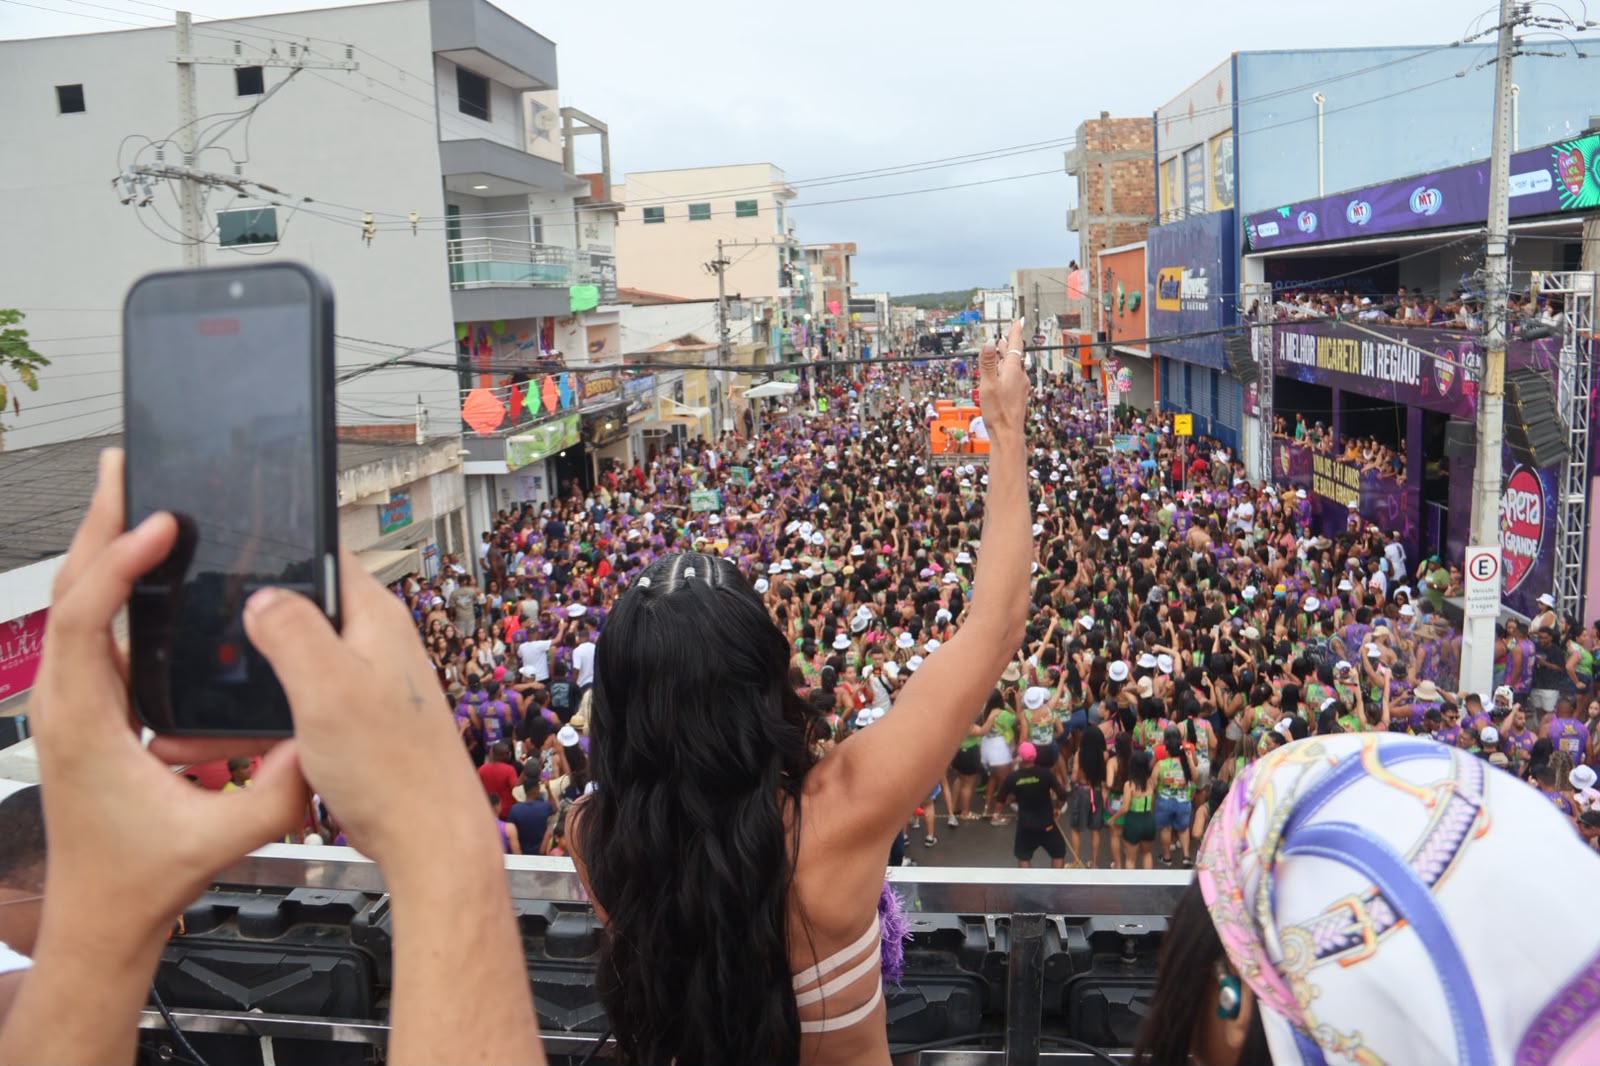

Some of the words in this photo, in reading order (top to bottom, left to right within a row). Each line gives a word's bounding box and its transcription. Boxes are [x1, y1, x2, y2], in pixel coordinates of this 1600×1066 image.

[1417, 192, 1432, 206] MT
[1352, 205, 1364, 217] MT
[1302, 215, 1311, 225] MT
[1279, 331, 1285, 360] A
[1286, 332, 1316, 367] MELHOR
[1317, 336, 1359, 375] MICARETA
[1361, 340, 1375, 378] DA
[1376, 337, 1420, 387] REGIÃO!
[1344, 464, 1360, 490] ANOS
[1505, 531, 1538, 560] GRANDE
[1478, 559, 1489, 576] E
